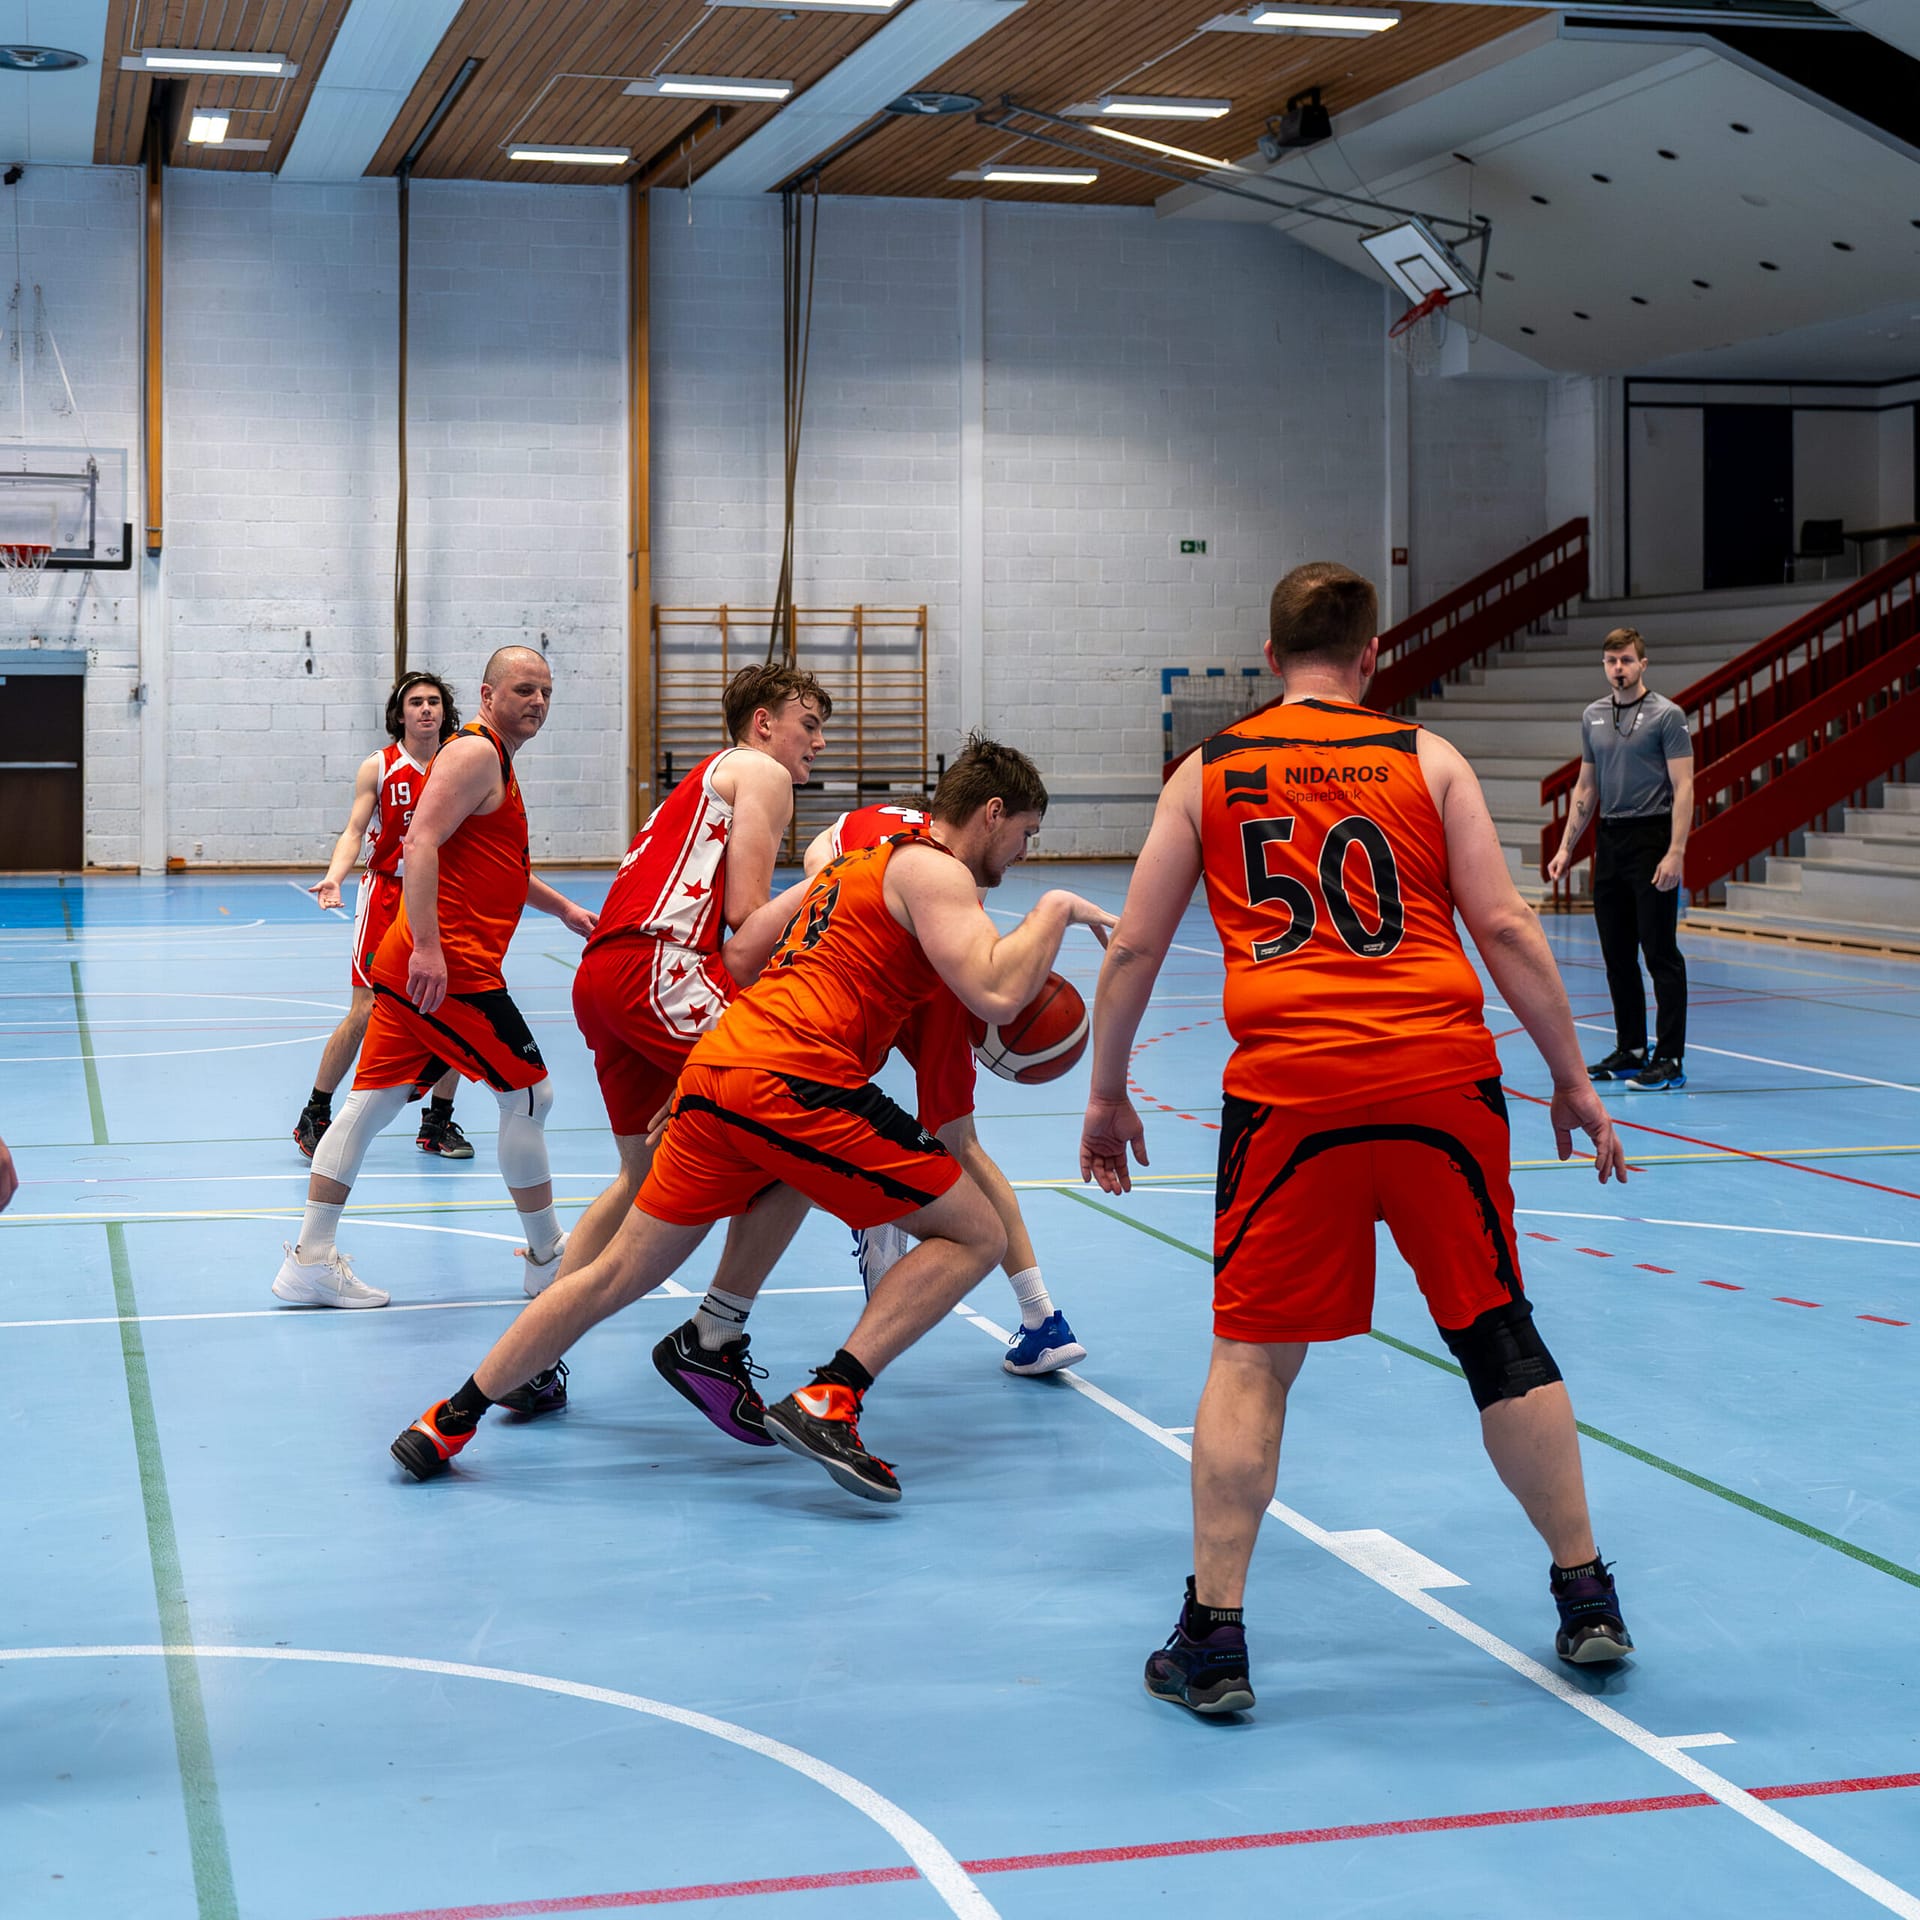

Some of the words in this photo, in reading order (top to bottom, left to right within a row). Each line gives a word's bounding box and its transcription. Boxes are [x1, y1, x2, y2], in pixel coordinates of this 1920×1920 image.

[1285, 766, 1389, 784] NIDAROS
[391, 782, 411, 806] 19
[1286, 788, 1361, 804] Sparebank
[1240, 815, 1406, 963] 50
[1561, 1565, 1596, 1581] PUMA
[1210, 1610, 1241, 1622] PUM
